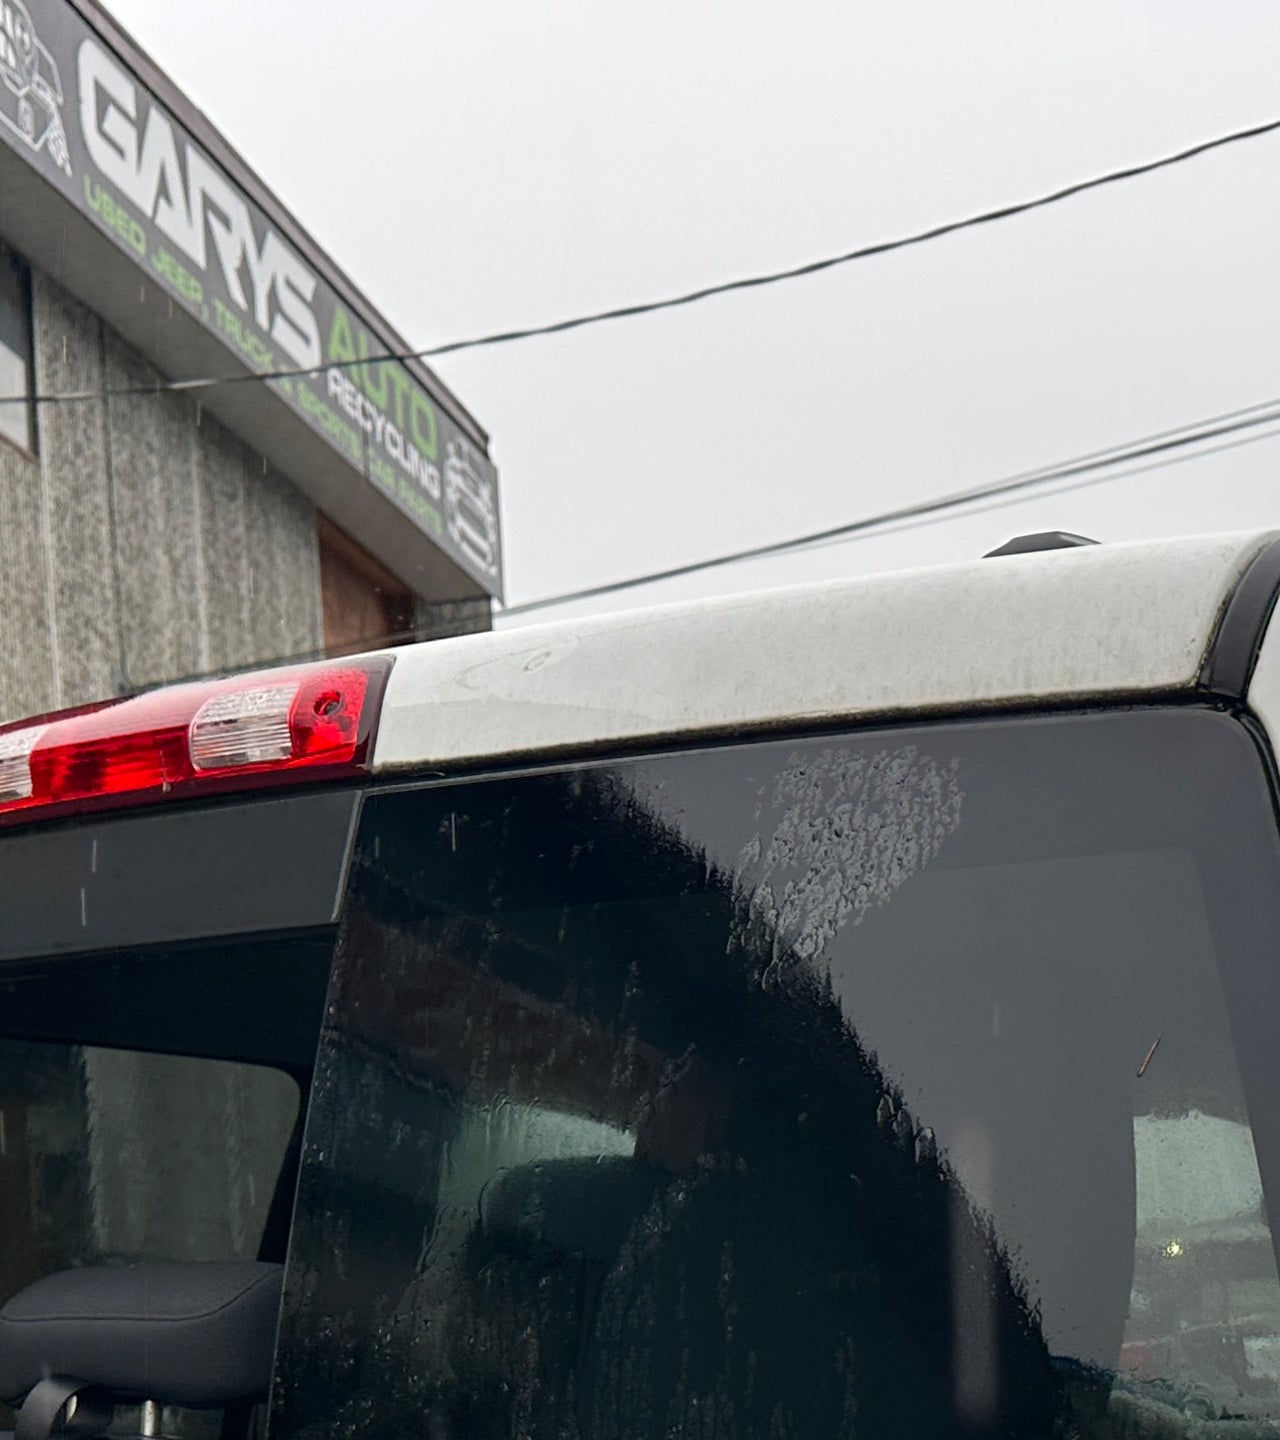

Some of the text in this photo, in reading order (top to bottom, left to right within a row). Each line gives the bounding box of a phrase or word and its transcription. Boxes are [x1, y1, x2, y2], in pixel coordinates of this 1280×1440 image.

[78, 37, 321, 380] GARYS
[83, 174, 147, 256] USED
[327, 304, 439, 462] AUTO
[327, 366, 441, 500] RECYCLING
